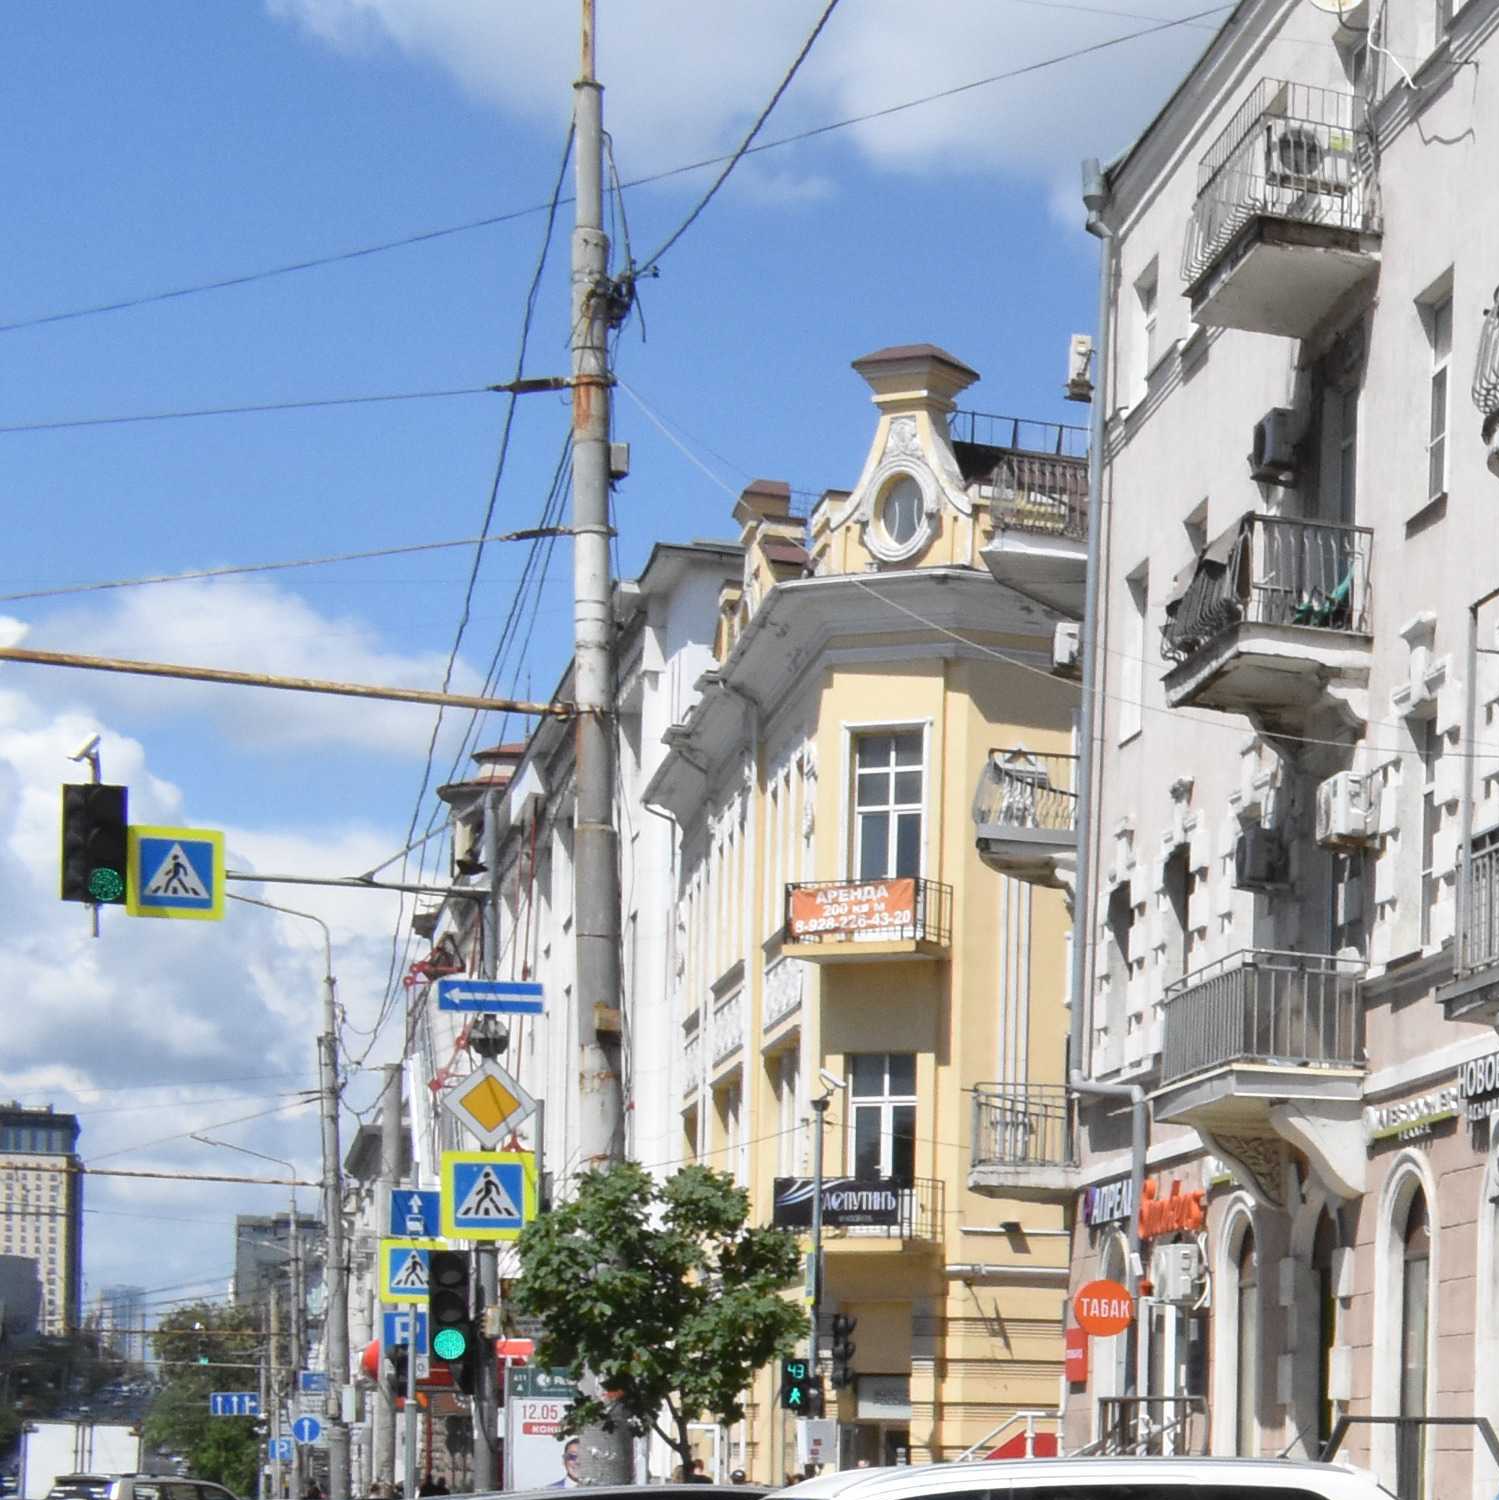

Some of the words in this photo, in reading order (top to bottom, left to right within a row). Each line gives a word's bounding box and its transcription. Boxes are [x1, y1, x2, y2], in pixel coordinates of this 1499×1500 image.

[816, 885, 889, 904] АРЕНДА
[823, 904, 848, 917] 200
[821, 1190, 897, 1212] АСПУТИНЪ
[1091, 1179, 1133, 1225] АПРЕЛ
[1081, 1298, 1131, 1318] ТАБАК
[787, 1364, 806, 1380] 43
[521, 1404, 559, 1421] 12.05
